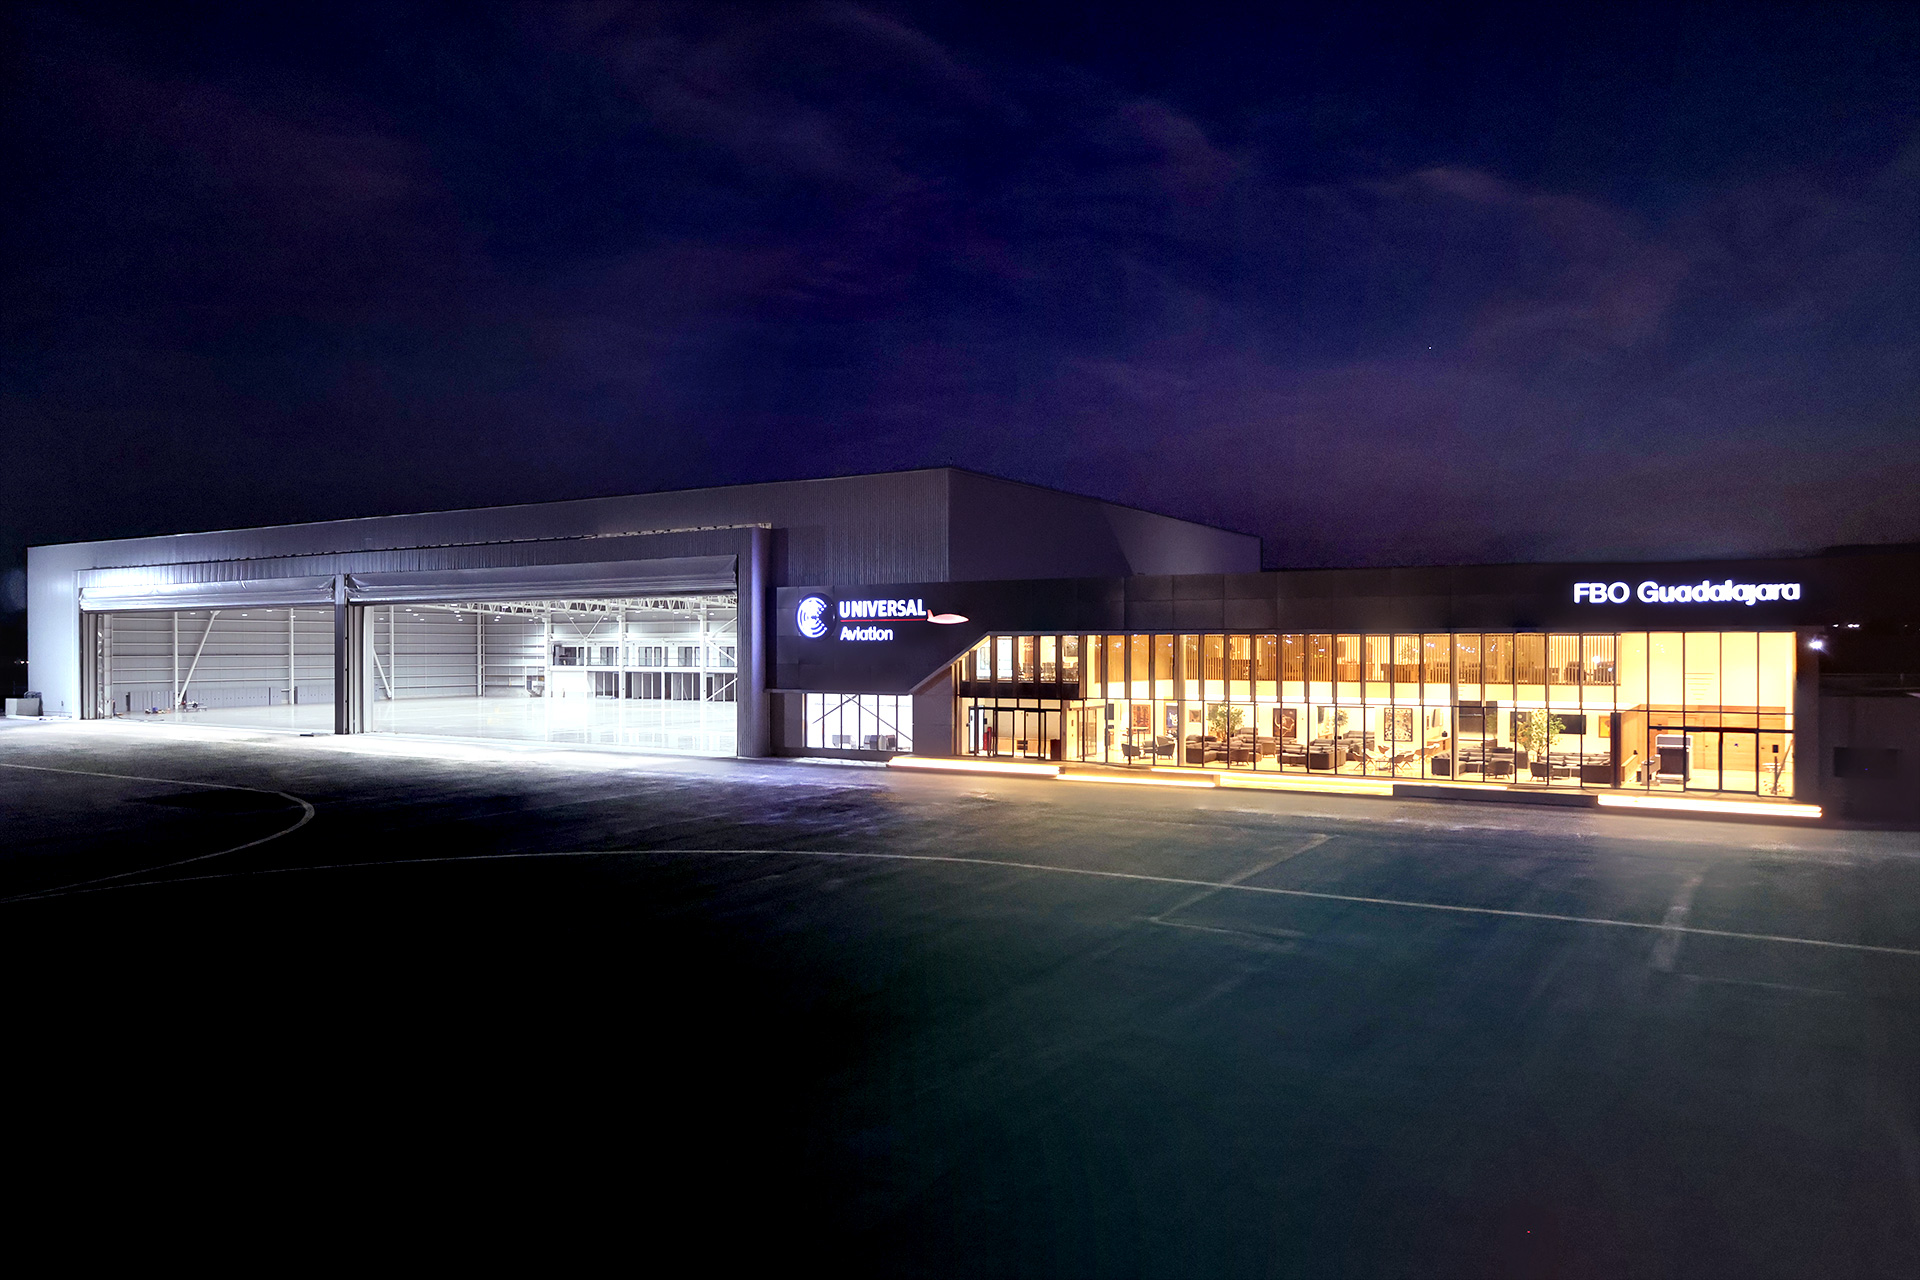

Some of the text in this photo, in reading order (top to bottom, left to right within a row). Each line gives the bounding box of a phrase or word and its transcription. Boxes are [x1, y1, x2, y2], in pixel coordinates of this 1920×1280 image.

[1573, 580, 1800, 605] FBO Guadalajara
[839, 599, 926, 618] UNIVERSAL
[840, 626, 893, 641] Aviation
